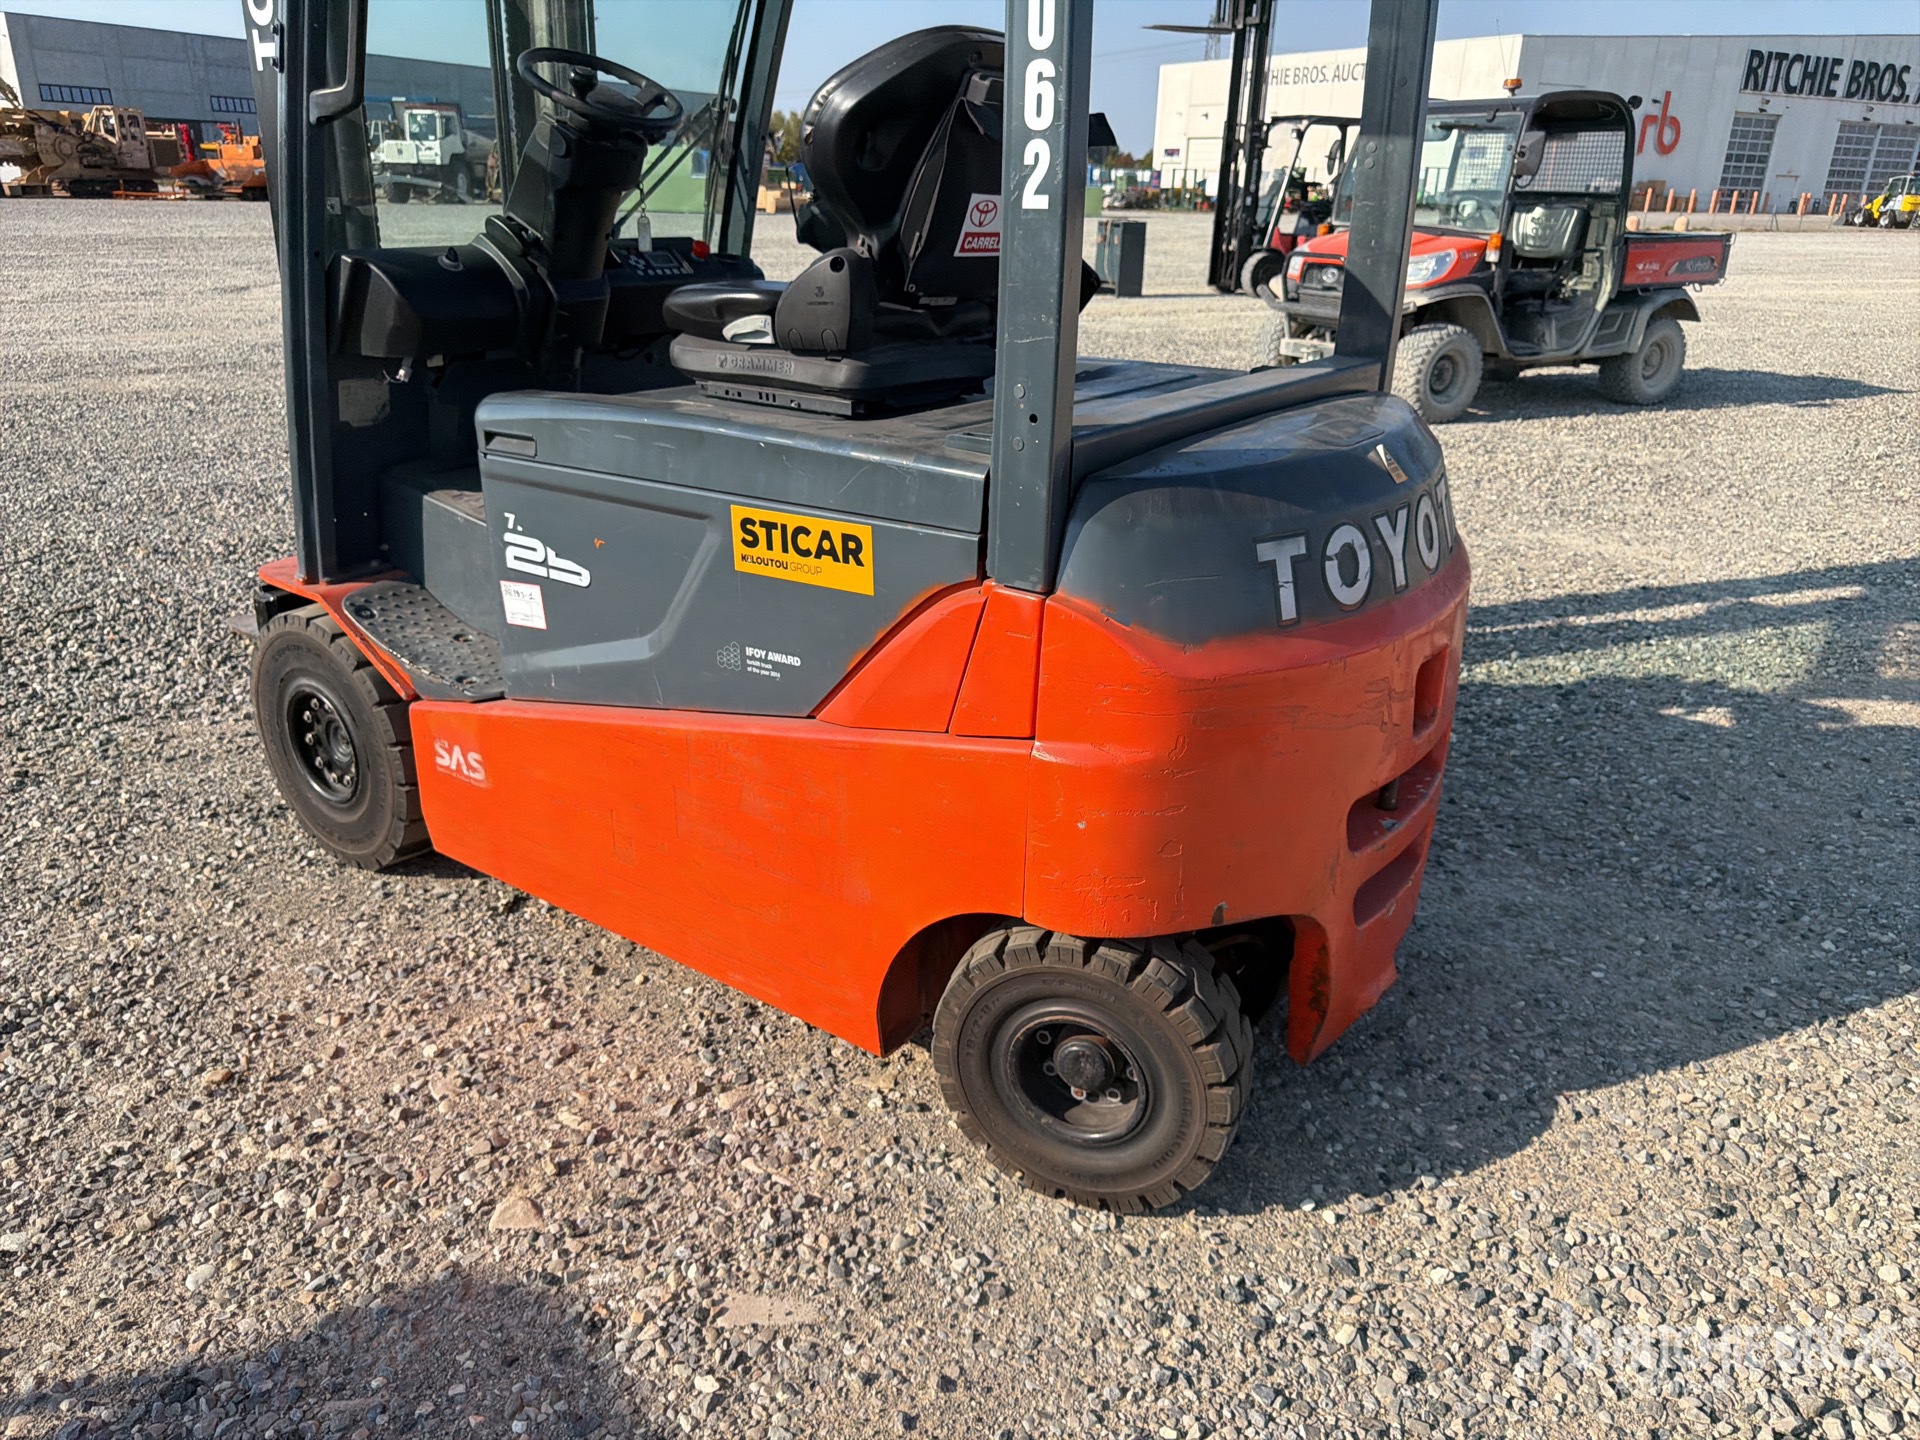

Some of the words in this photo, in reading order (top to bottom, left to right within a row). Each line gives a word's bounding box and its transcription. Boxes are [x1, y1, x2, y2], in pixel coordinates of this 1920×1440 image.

[247, 0, 276, 72] TO
[1292, 64, 1329, 85] BROS.
[1331, 62, 1367, 83] AUCT
[1742, 48, 1845, 98] RITCHIE
[1844, 59, 1911, 104] BROS.
[1637, 89, 1682, 155] rb
[963, 236, 1000, 250] CARREL
[728, 355, 794, 376] GRAMMER
[739, 516, 865, 568] STICAR
[1255, 472, 1454, 623] TOYOT
[789, 561, 823, 576] GROUP
[745, 646, 767, 660] IFOY
[767, 650, 802, 667] AWARD
[433, 738, 486, 781] SAS
